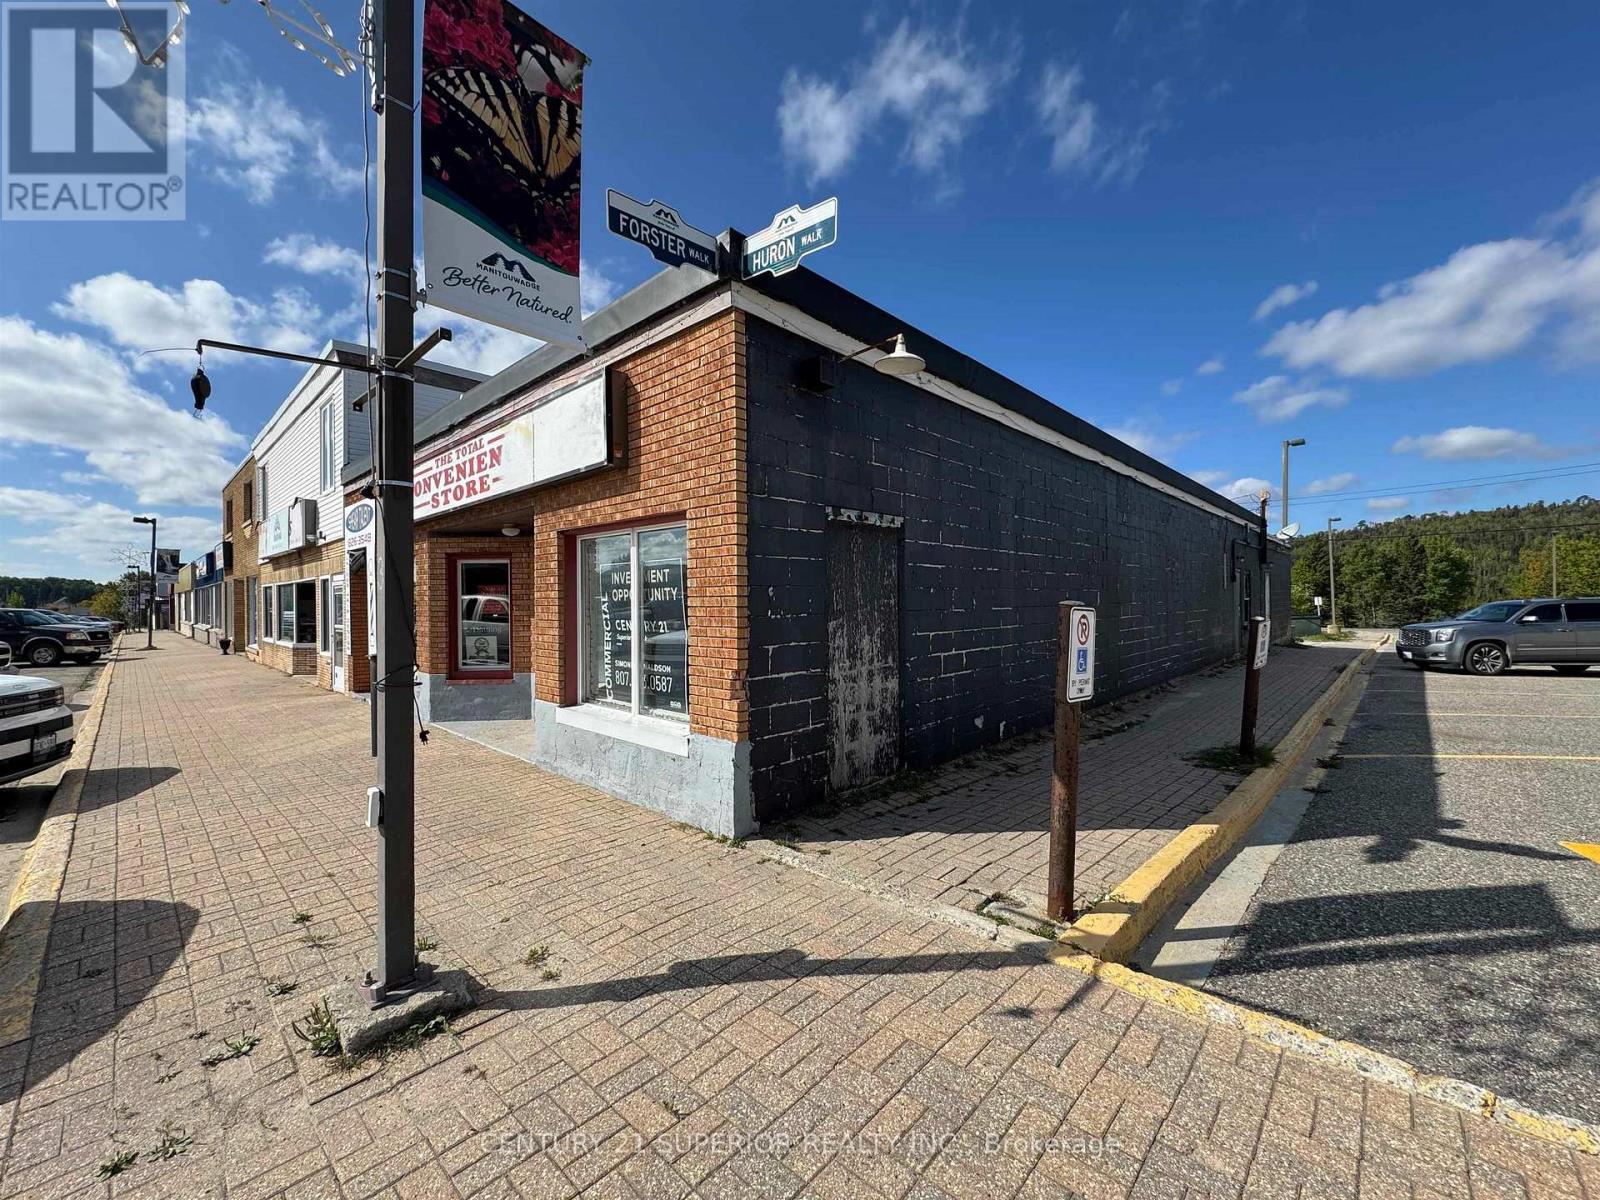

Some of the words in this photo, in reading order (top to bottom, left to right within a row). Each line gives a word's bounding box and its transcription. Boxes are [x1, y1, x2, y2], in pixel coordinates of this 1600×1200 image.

[619, 212, 686, 258] FORSTER
[688, 248, 710, 265] WALK
[753, 237, 795, 272] HURON
[801, 227, 822, 247] WALK
[442, 266, 500, 295] Better
[502, 286, 573, 324] Natured.
[476, 262, 542, 291] MANITOUWADGE
[414, 444, 503, 498] ONVENIEN
[434, 452, 453, 469] THE
[456, 437, 485, 460] TOTAL
[431, 474, 491, 509] STORE
[612, 587, 678, 602] OPPUNITY
[601, 592, 614, 700] COMMERCIAL
[615, 620, 656, 633] CENRY
[658, 621, 668, 633] 21
